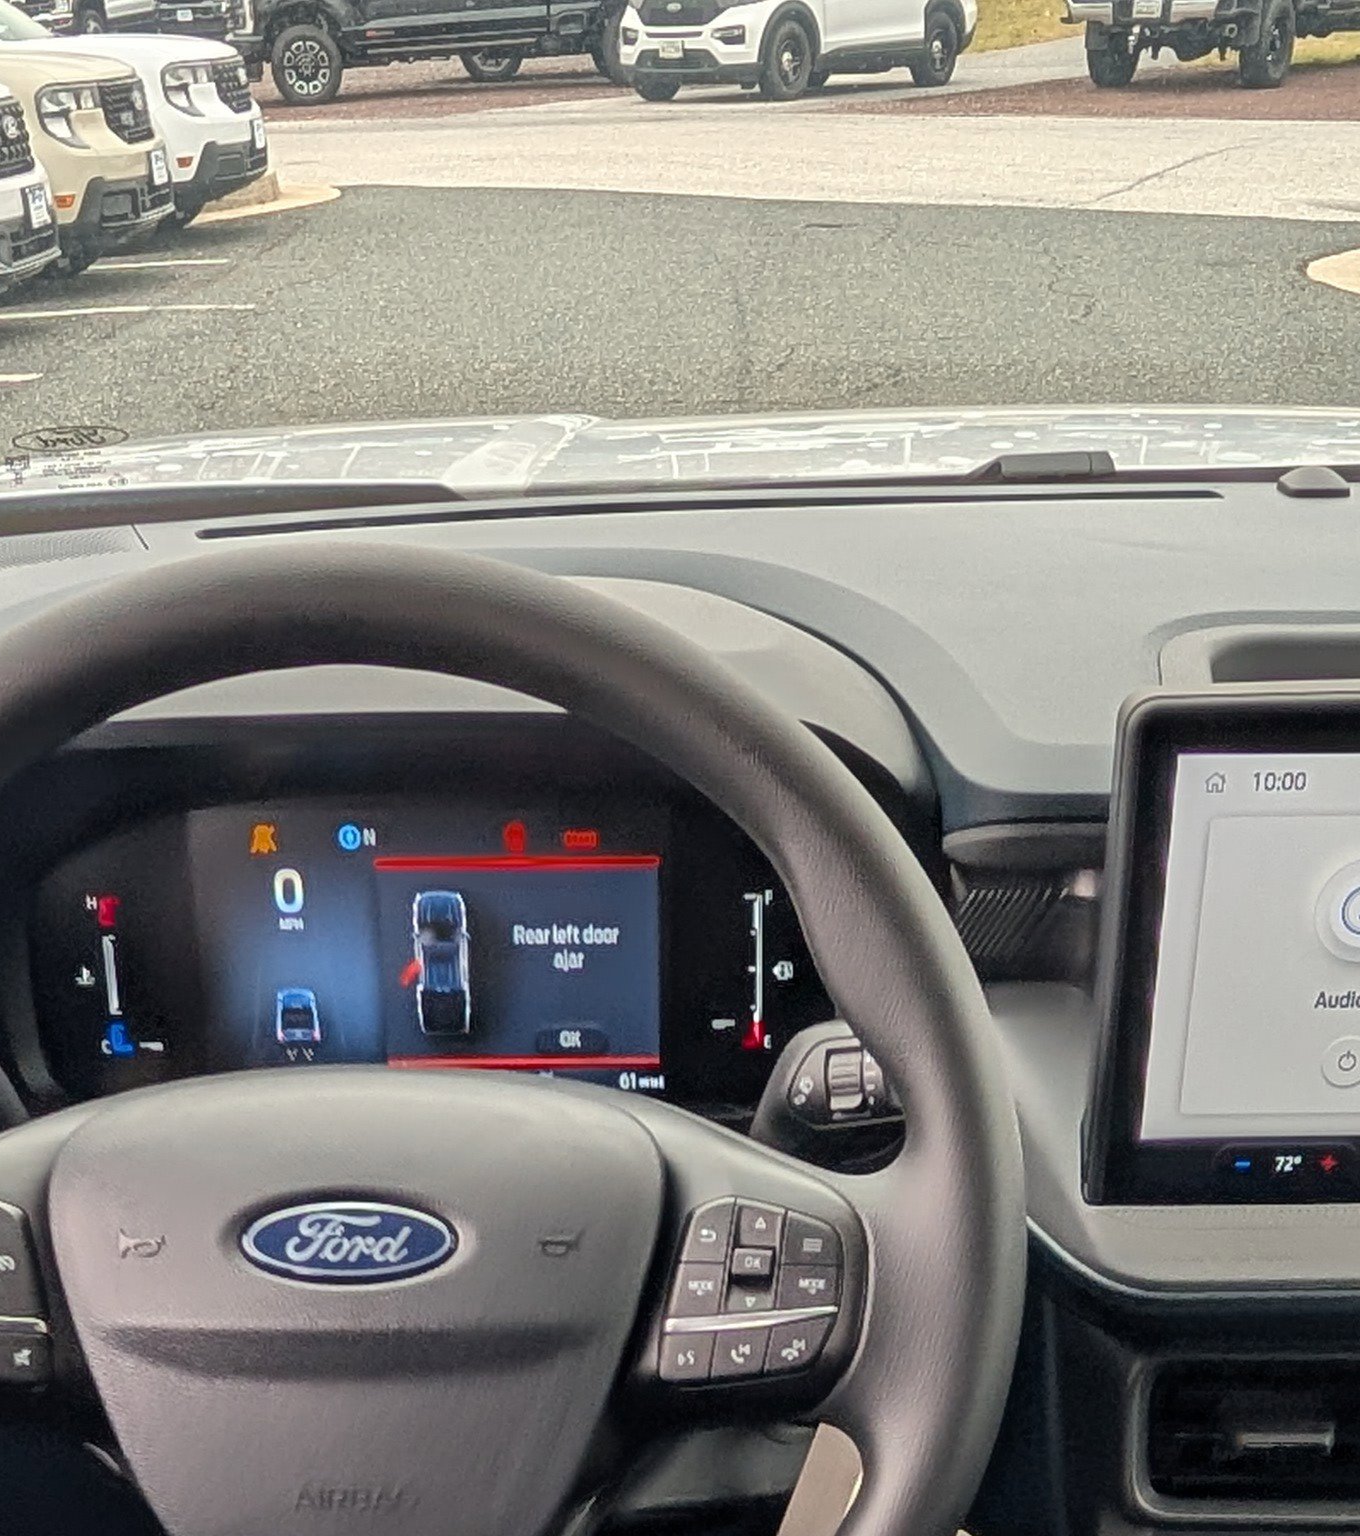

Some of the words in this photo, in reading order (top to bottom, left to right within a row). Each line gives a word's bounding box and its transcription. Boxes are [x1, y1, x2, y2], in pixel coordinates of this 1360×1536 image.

[1252, 772, 1308, 792] 10:00
[363, 828, 376, 846] N
[274, 868, 304, 913] 0
[86, 895, 98, 910] H
[513, 924, 550, 945] Rear
[552, 923, 581, 945] left
[582, 923, 619, 945] door
[553, 948, 585, 972] ajar
[559, 1030, 581, 1048] OK
[1274, 1154, 1303, 1173] 72°
[285, 1214, 410, 1264] Ford
[744, 1256, 762, 1270] OK
